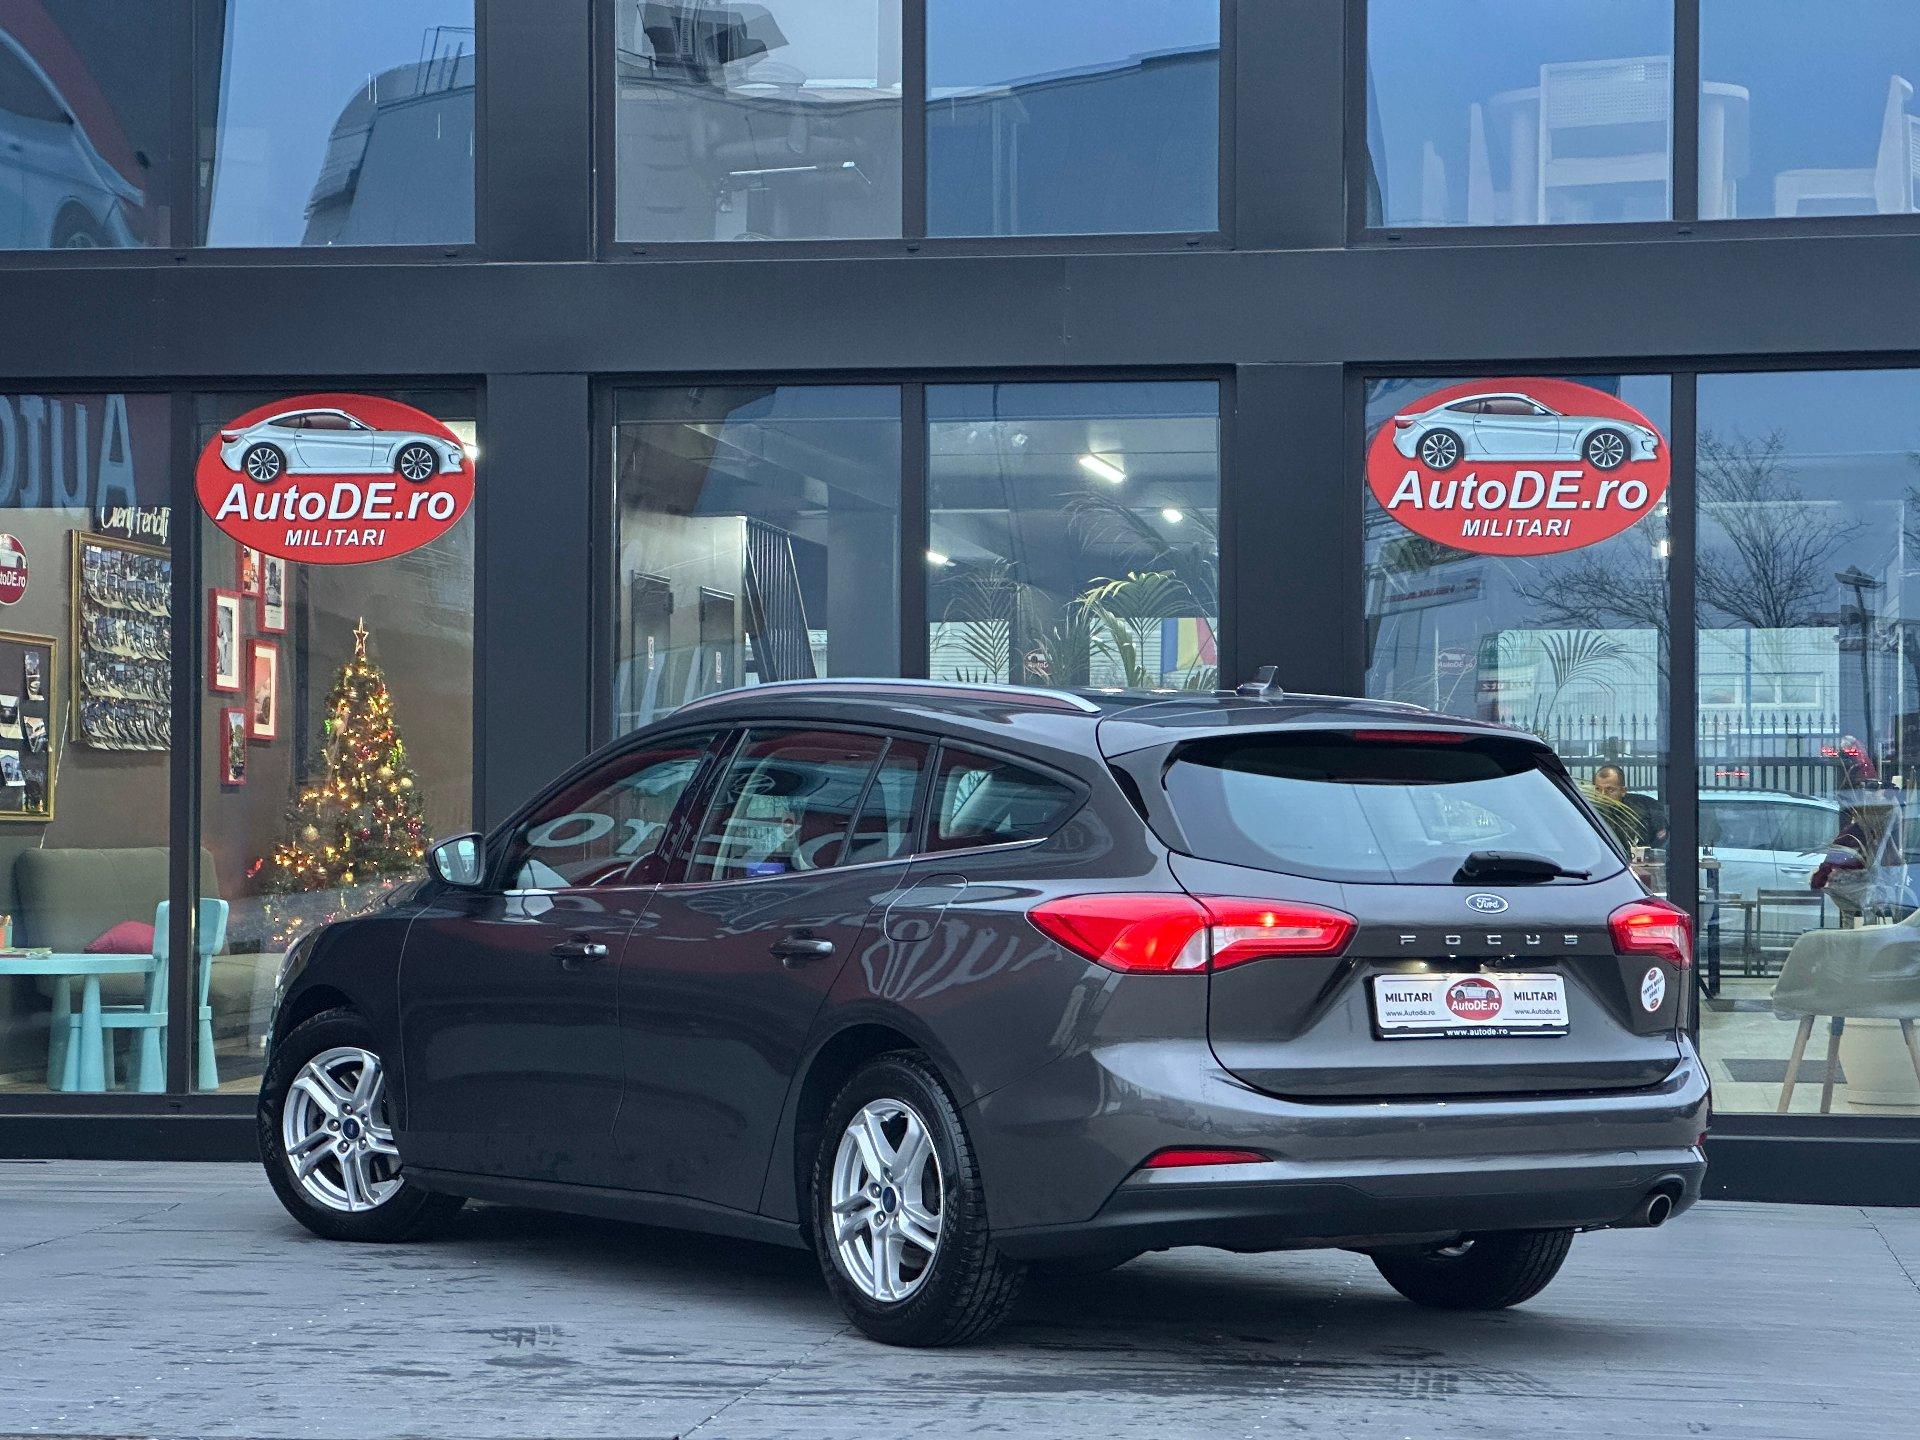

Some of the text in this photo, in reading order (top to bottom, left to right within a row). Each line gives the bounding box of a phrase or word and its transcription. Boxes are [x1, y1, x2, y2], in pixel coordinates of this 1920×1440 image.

[1387, 470, 1649, 510] AutoDE.ro
[215, 482, 456, 522] AutoDE.ro
[1461, 518, 1572, 538] MILITARI
[284, 528, 386, 547] MILITARI
[1476, 897, 1500, 909] Ford
[1399, 934, 1579, 946] FOCUS
[1385, 992, 1433, 1003] MILITARI
[1513, 991, 1558, 1002] MILITARI
[1451, 1000, 1500, 1012] AutoDE.ro
[1514, 1008, 1561, 1016] www.Autode.ro
[1386, 1008, 1436, 1017] www.Autode.ro
[1446, 1027, 1508, 1036] www.autode.ro
